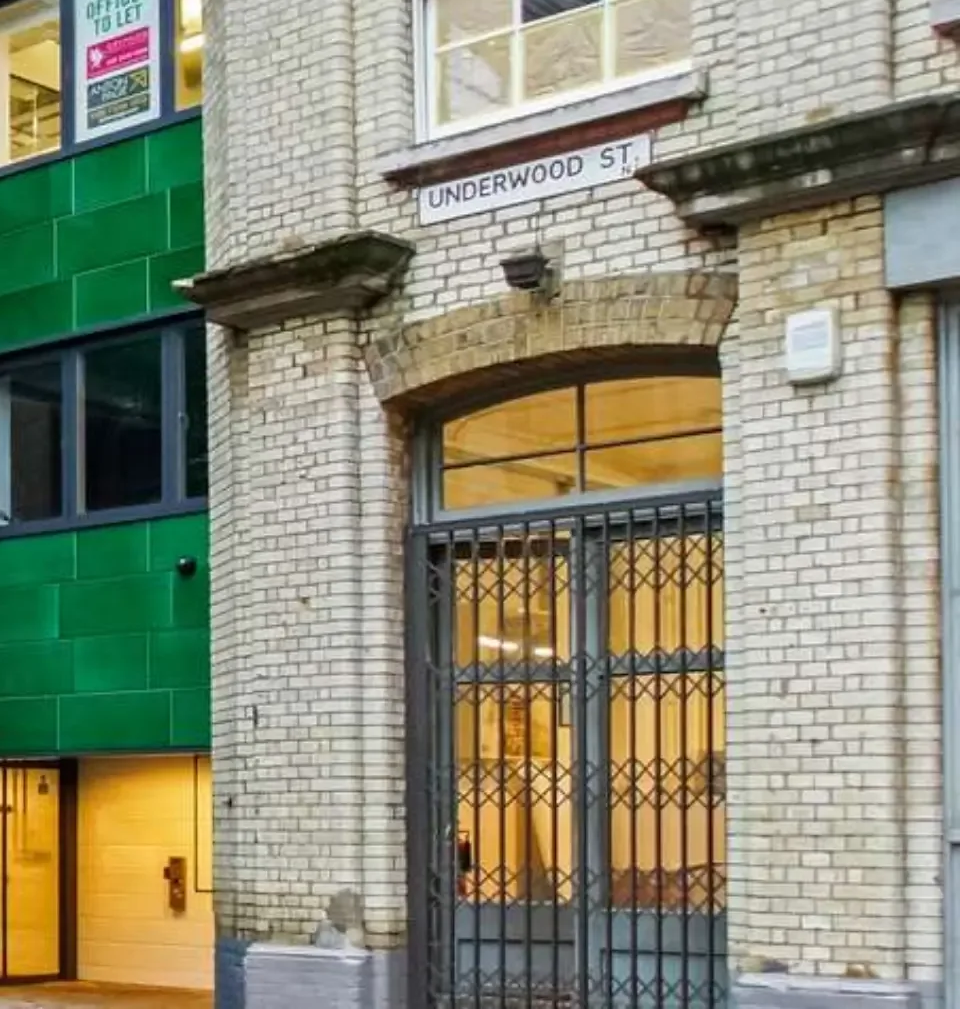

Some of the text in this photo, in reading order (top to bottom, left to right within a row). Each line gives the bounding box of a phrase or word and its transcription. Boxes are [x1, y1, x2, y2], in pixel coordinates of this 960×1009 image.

[94, 3, 143, 35] TO LET
[428, 155, 583, 208] UNDERWOOD
